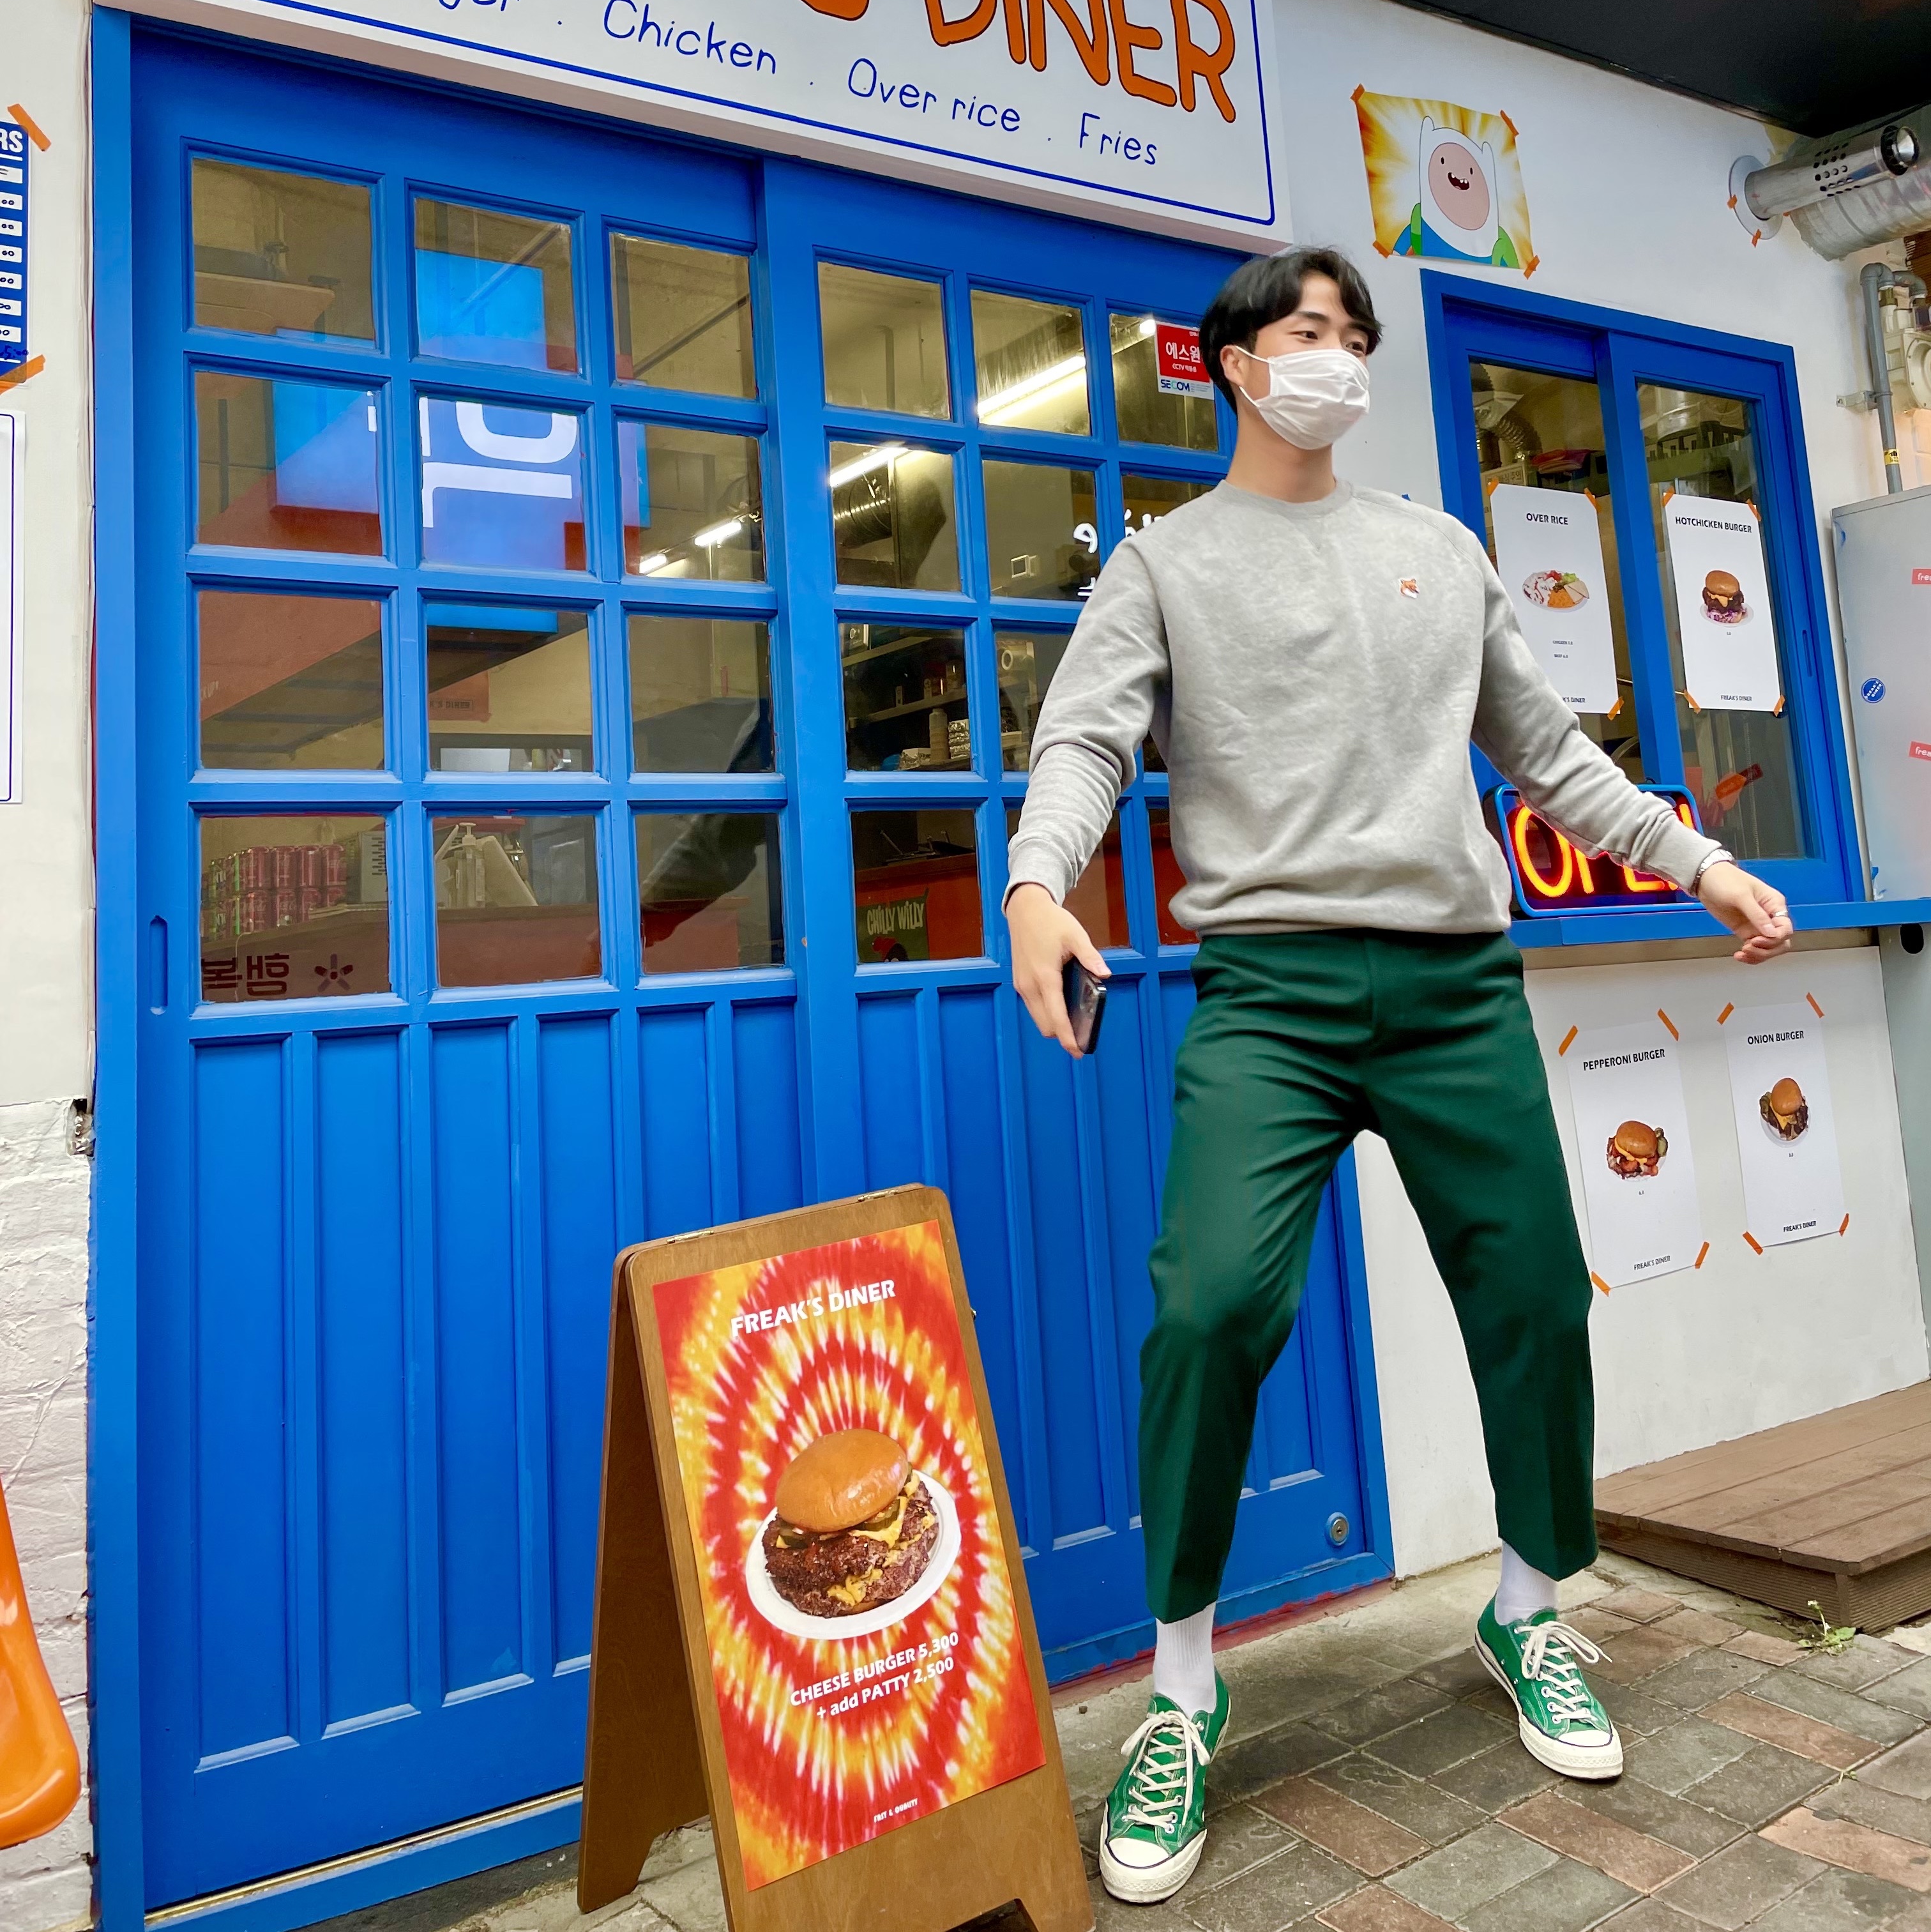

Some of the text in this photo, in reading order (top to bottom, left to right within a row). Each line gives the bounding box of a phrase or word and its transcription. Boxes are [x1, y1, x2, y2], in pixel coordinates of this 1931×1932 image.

[603, 0, 1157, 165] Chicken Over rice Fries
[1160, 379, 1190, 392] SECOM
[1526, 512, 1569, 525] OVER RICE
[1675, 516, 1752, 533] HOTCHICKEN BURGER
[1747, 1030, 1805, 1045] ONION BURGER
[1583, 1048, 1665, 1071] PEPPERONI BURGER
[1783, 1223, 1802, 1233] FREAK'S
[1633, 1259, 1655, 1271] FREAK'S
[731, 1279, 896, 1337] FREAK'S DINER
[789, 1631, 959, 1706] CHEESE BURGER 5,300
[830, 1692, 859, 1716] add
[861, 1671, 910, 1704] PATTY
[913, 1656, 955, 1684] 2,500
